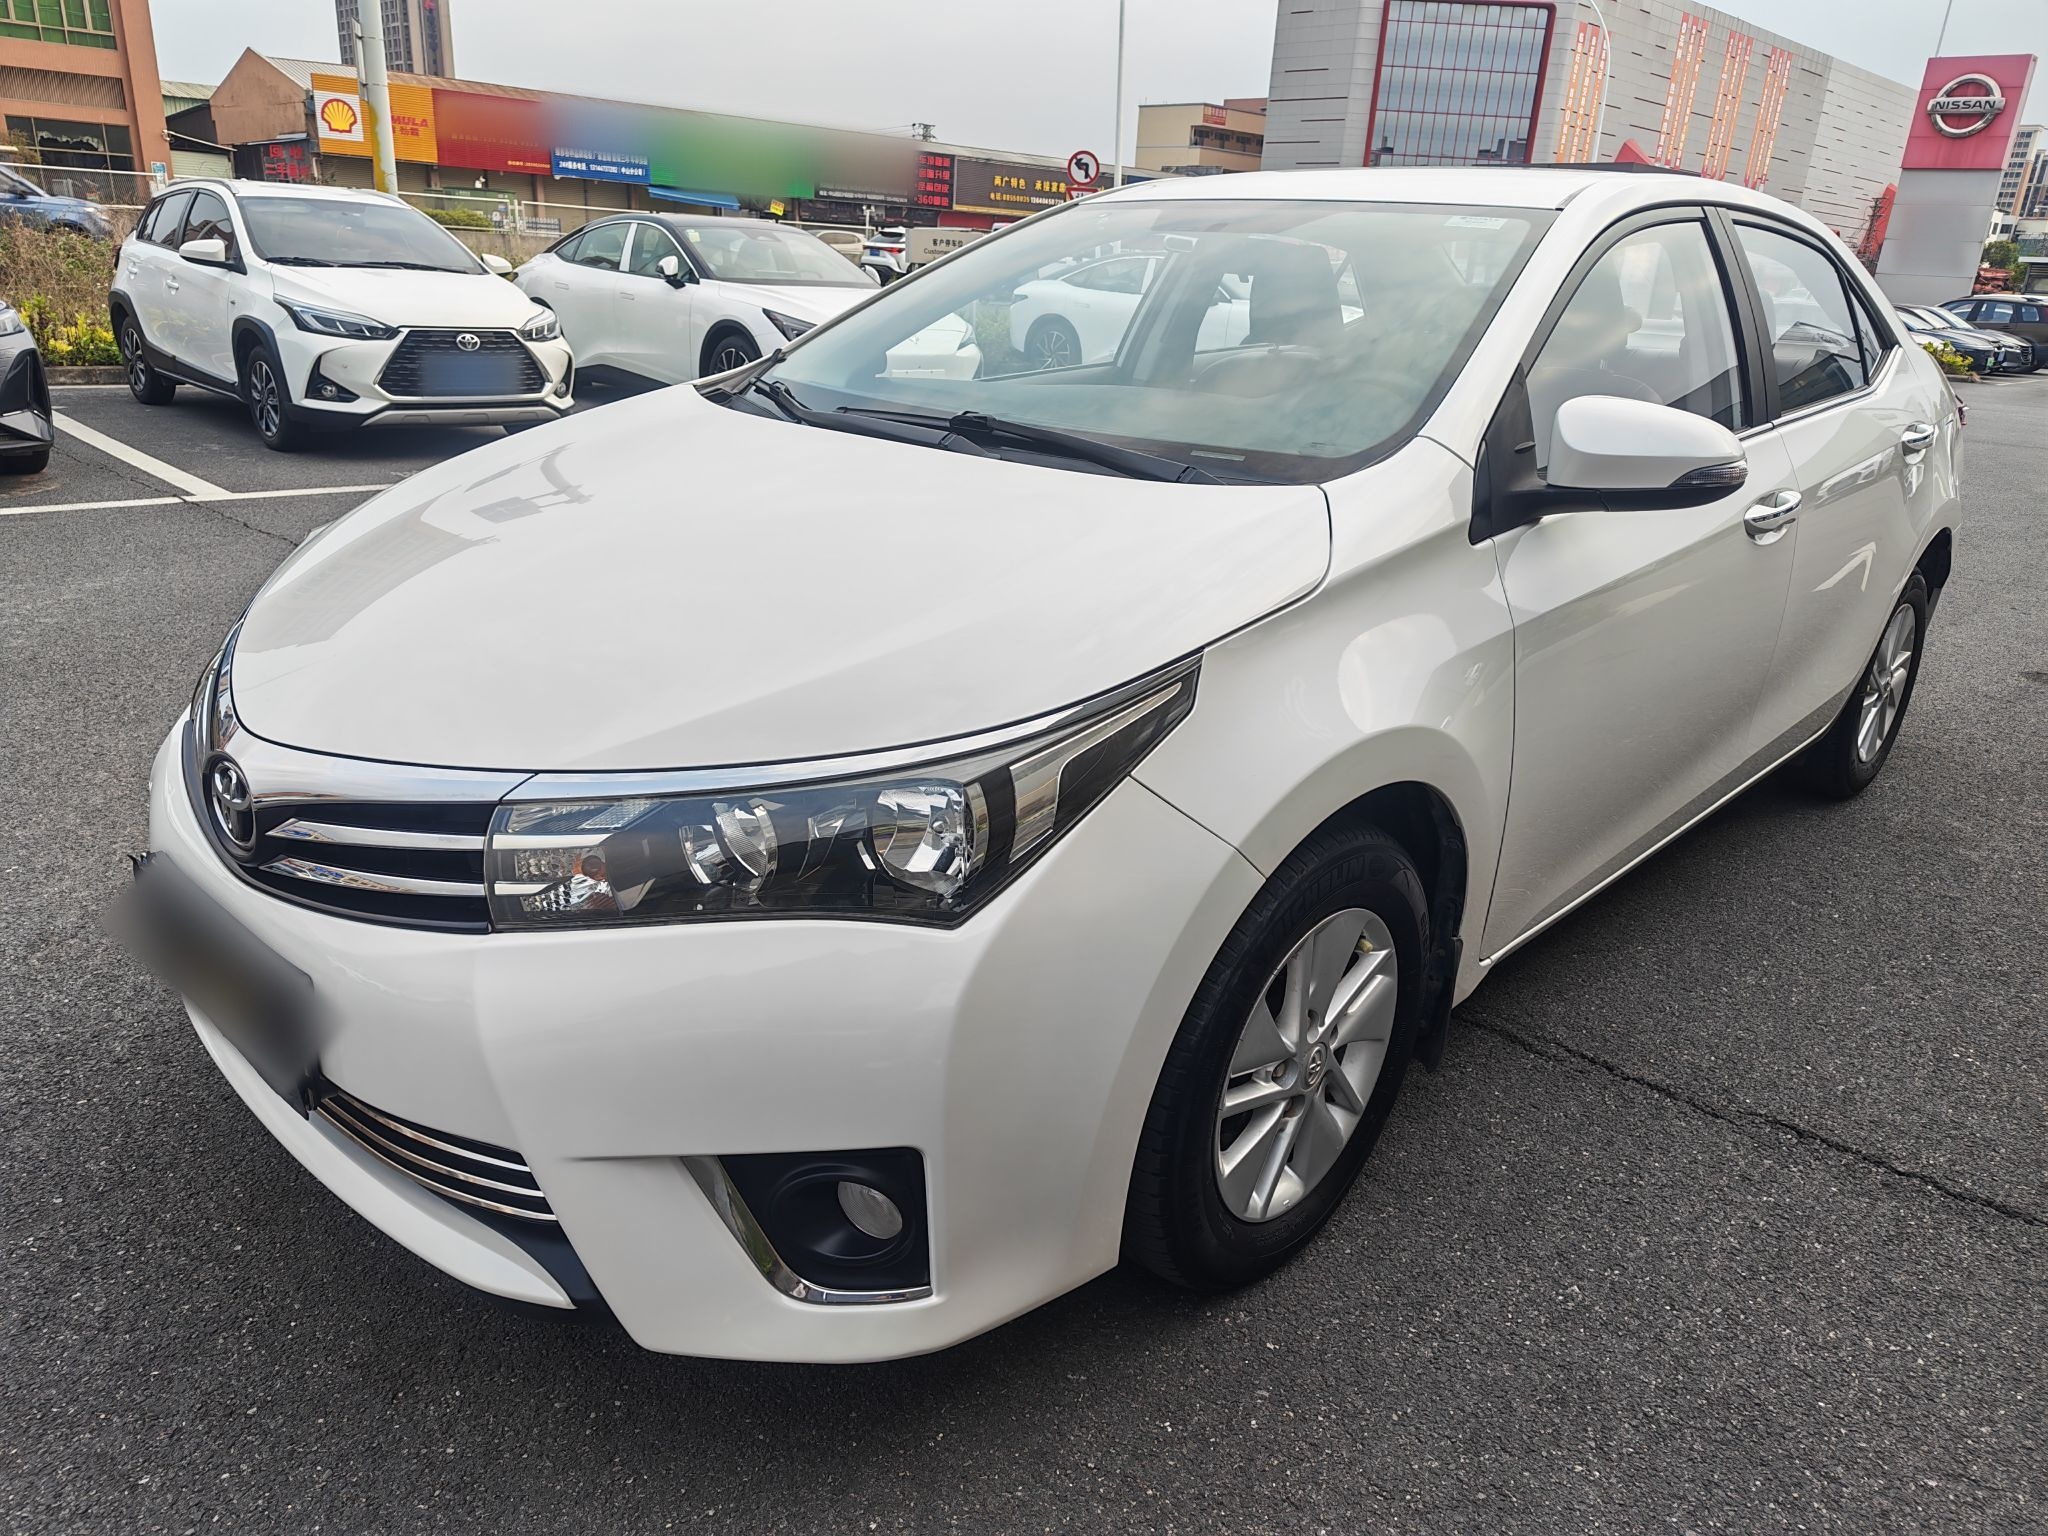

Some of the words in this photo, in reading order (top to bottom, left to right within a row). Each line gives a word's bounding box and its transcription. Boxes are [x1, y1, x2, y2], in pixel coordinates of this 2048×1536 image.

[1934, 100, 1996, 110] NISSAN
[391, 115, 429, 127] MULA
[993, 175, 1026, 190] 两广特色
[932, 238, 964, 248] 客户停车位
